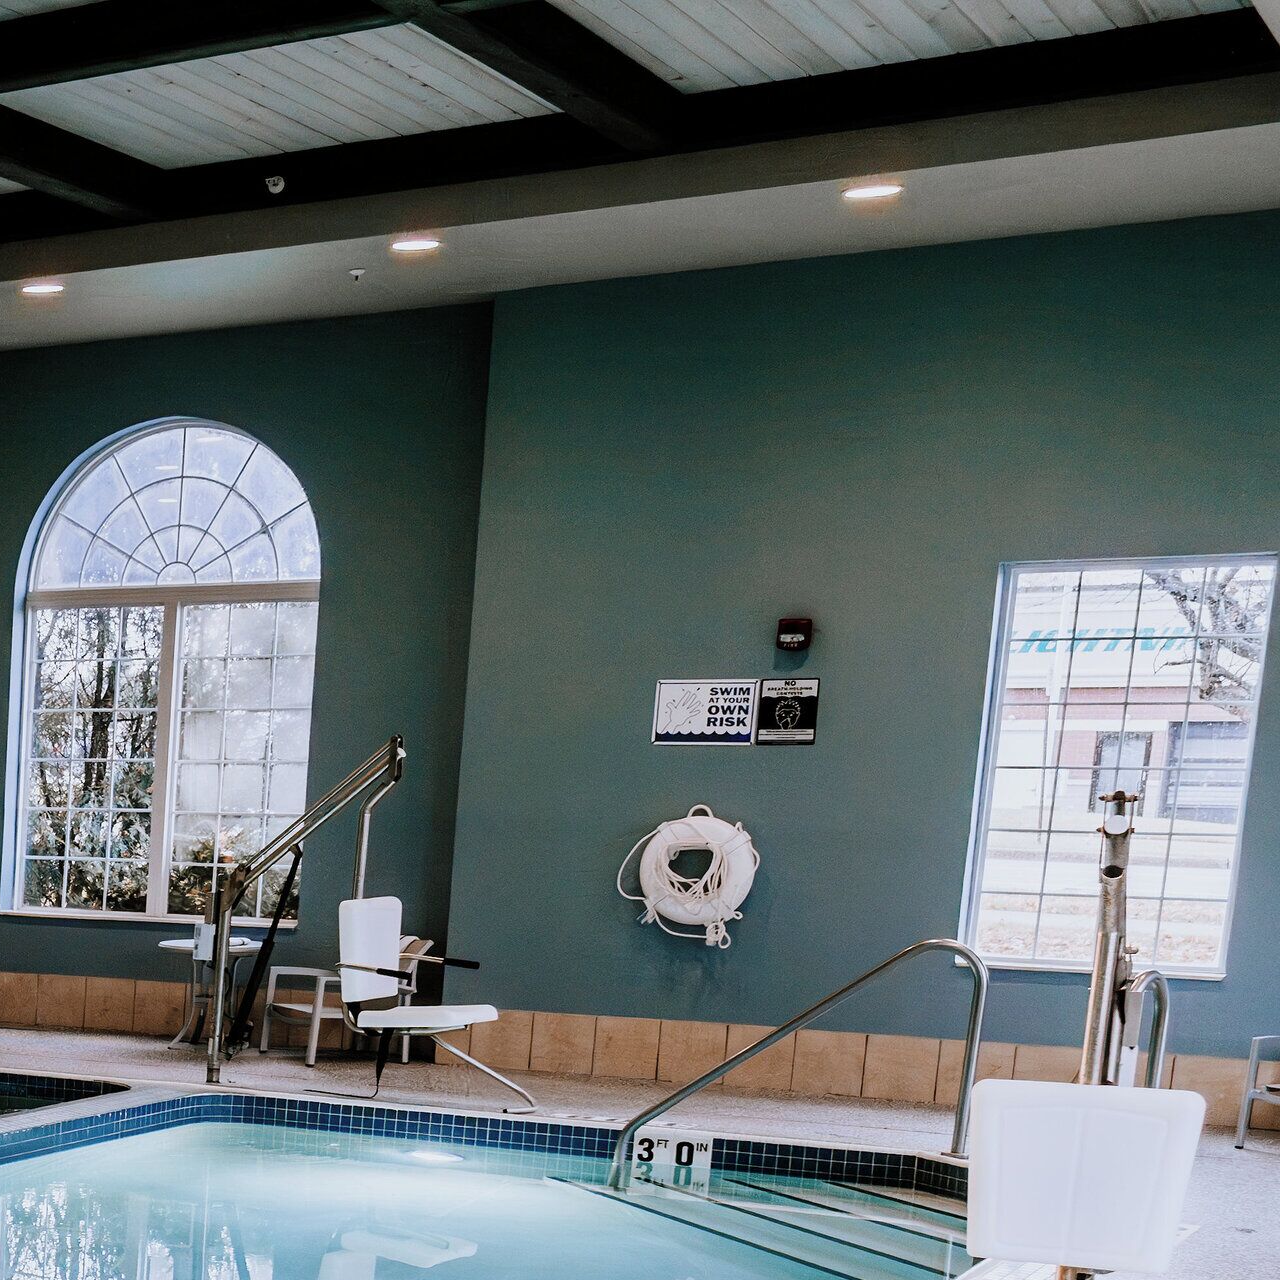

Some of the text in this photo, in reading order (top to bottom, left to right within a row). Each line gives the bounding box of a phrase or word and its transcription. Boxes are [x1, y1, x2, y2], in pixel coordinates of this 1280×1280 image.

[709, 687, 751, 696] SWIM
[707, 705, 749, 715] OWN
[706, 717, 748, 727] RISK
[637, 1137, 655, 1162] 3
[675, 1141, 695, 1167] 0
